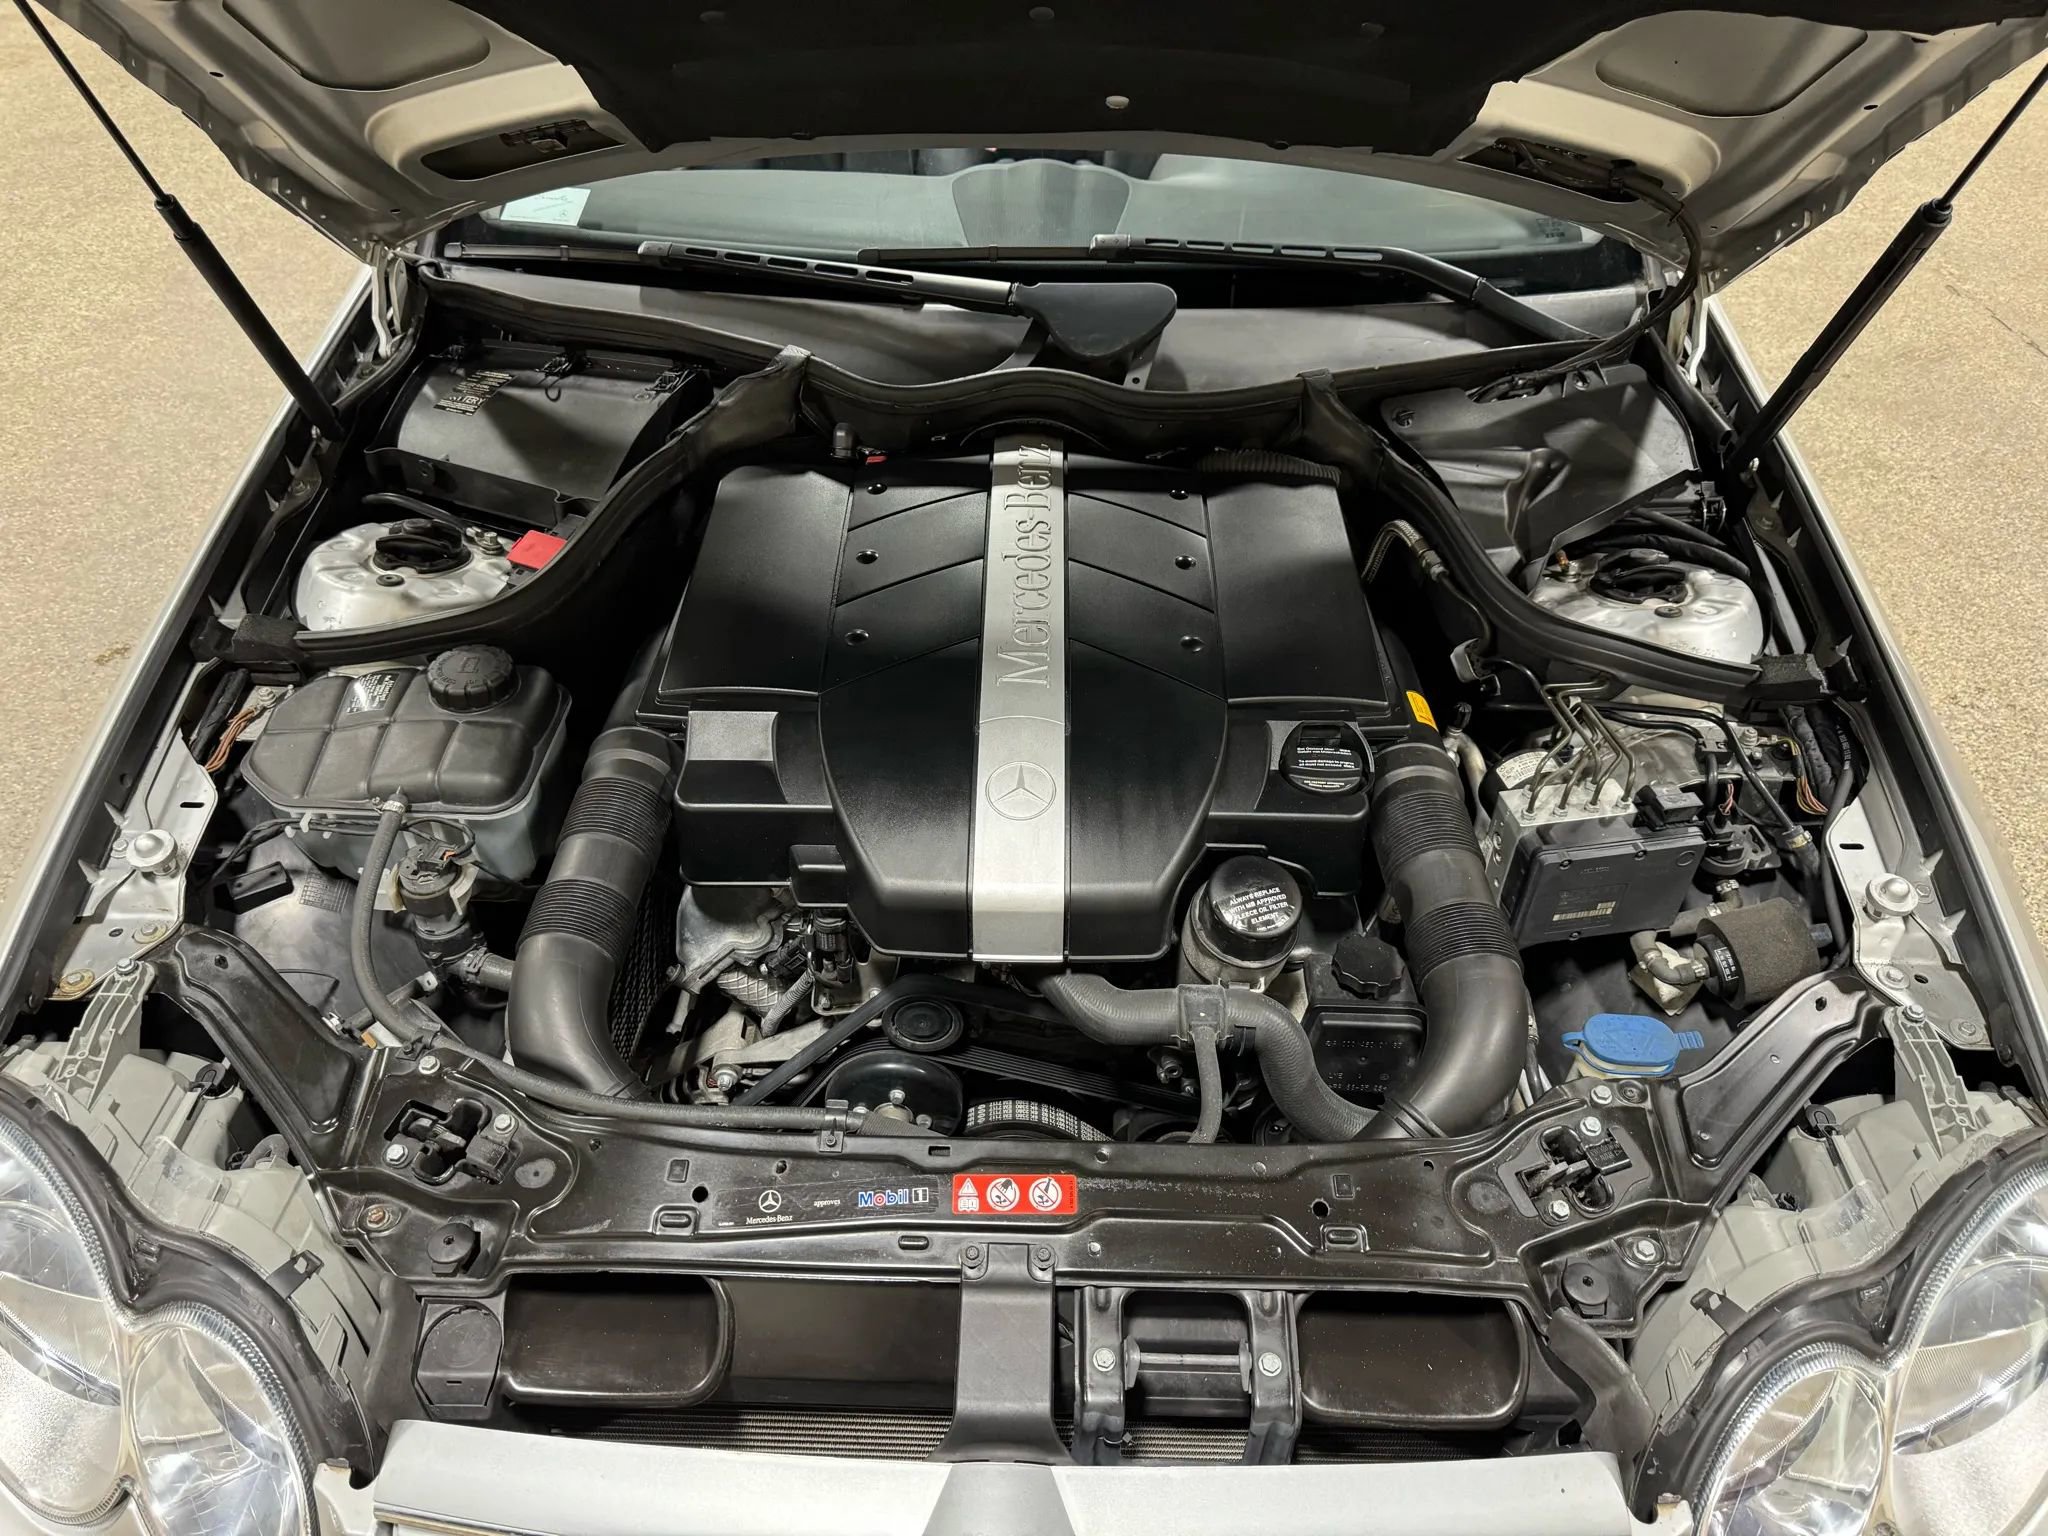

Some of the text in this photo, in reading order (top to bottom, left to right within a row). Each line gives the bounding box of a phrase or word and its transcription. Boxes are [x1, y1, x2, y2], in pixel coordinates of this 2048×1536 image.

[996, 443, 1051, 688] Mercedes-Benz
[1228, 905, 1246, 914] WITH
[1256, 893, 1287, 906] APPROVED
[1229, 887, 1281, 906] ALWAYS REPLACE
[1269, 901, 1289, 911] FILTER
[1251, 912, 1279, 925] ELEMENT
[813, 1199, 841, 1208] approves
[858, 1189, 909, 1207] Mobil
